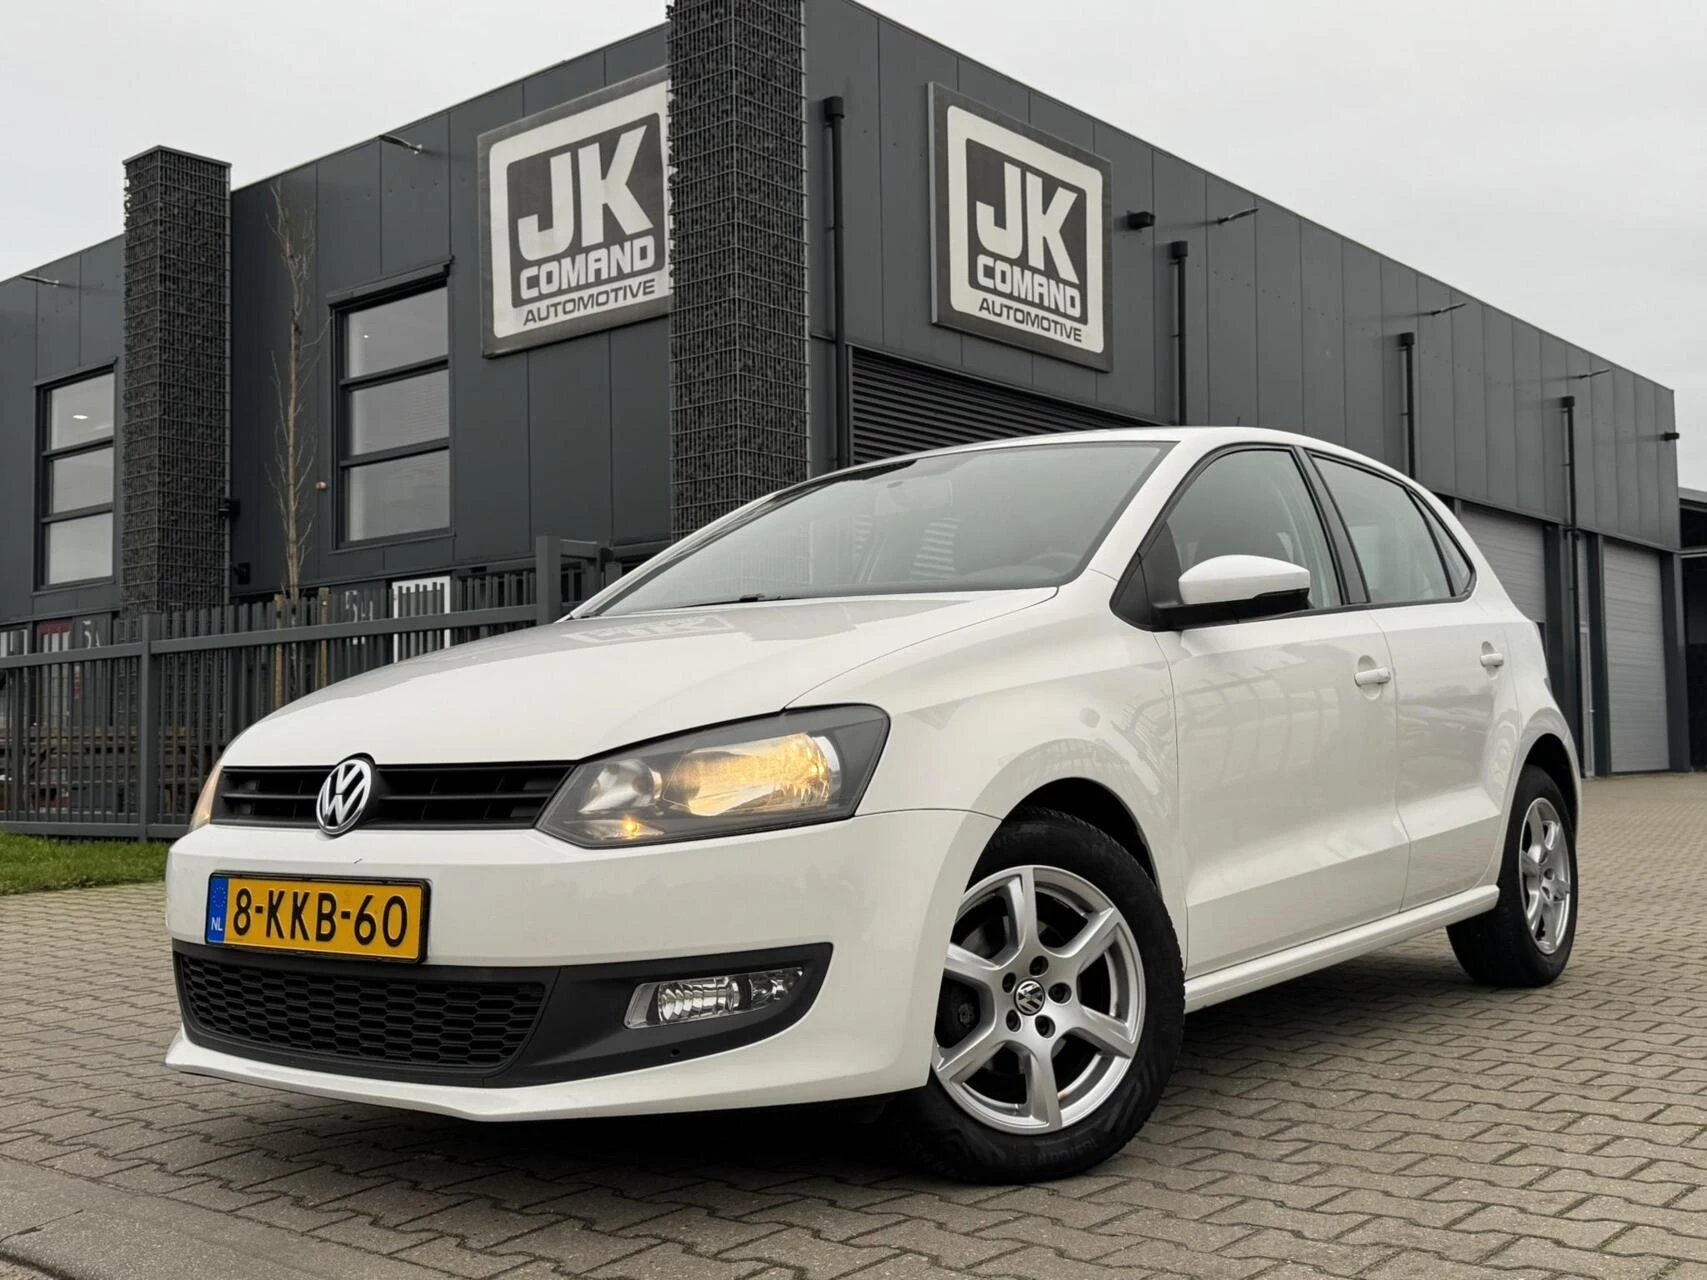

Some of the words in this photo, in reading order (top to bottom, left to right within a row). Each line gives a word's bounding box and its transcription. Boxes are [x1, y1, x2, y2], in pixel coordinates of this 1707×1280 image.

[517, 125, 654, 262] JK
[976, 161, 1080, 284] JK
[520, 235, 655, 299] COMAND
[977, 254, 1081, 318] COMAND
[523, 278, 656, 326] AUTOMOTIVE
[978, 298, 1082, 342] AUTOMOTIVE
[317, 758, 371, 834] VW
[211, 916, 223, 932] NL
[233, 888, 408, 948] 8-KKB-60
